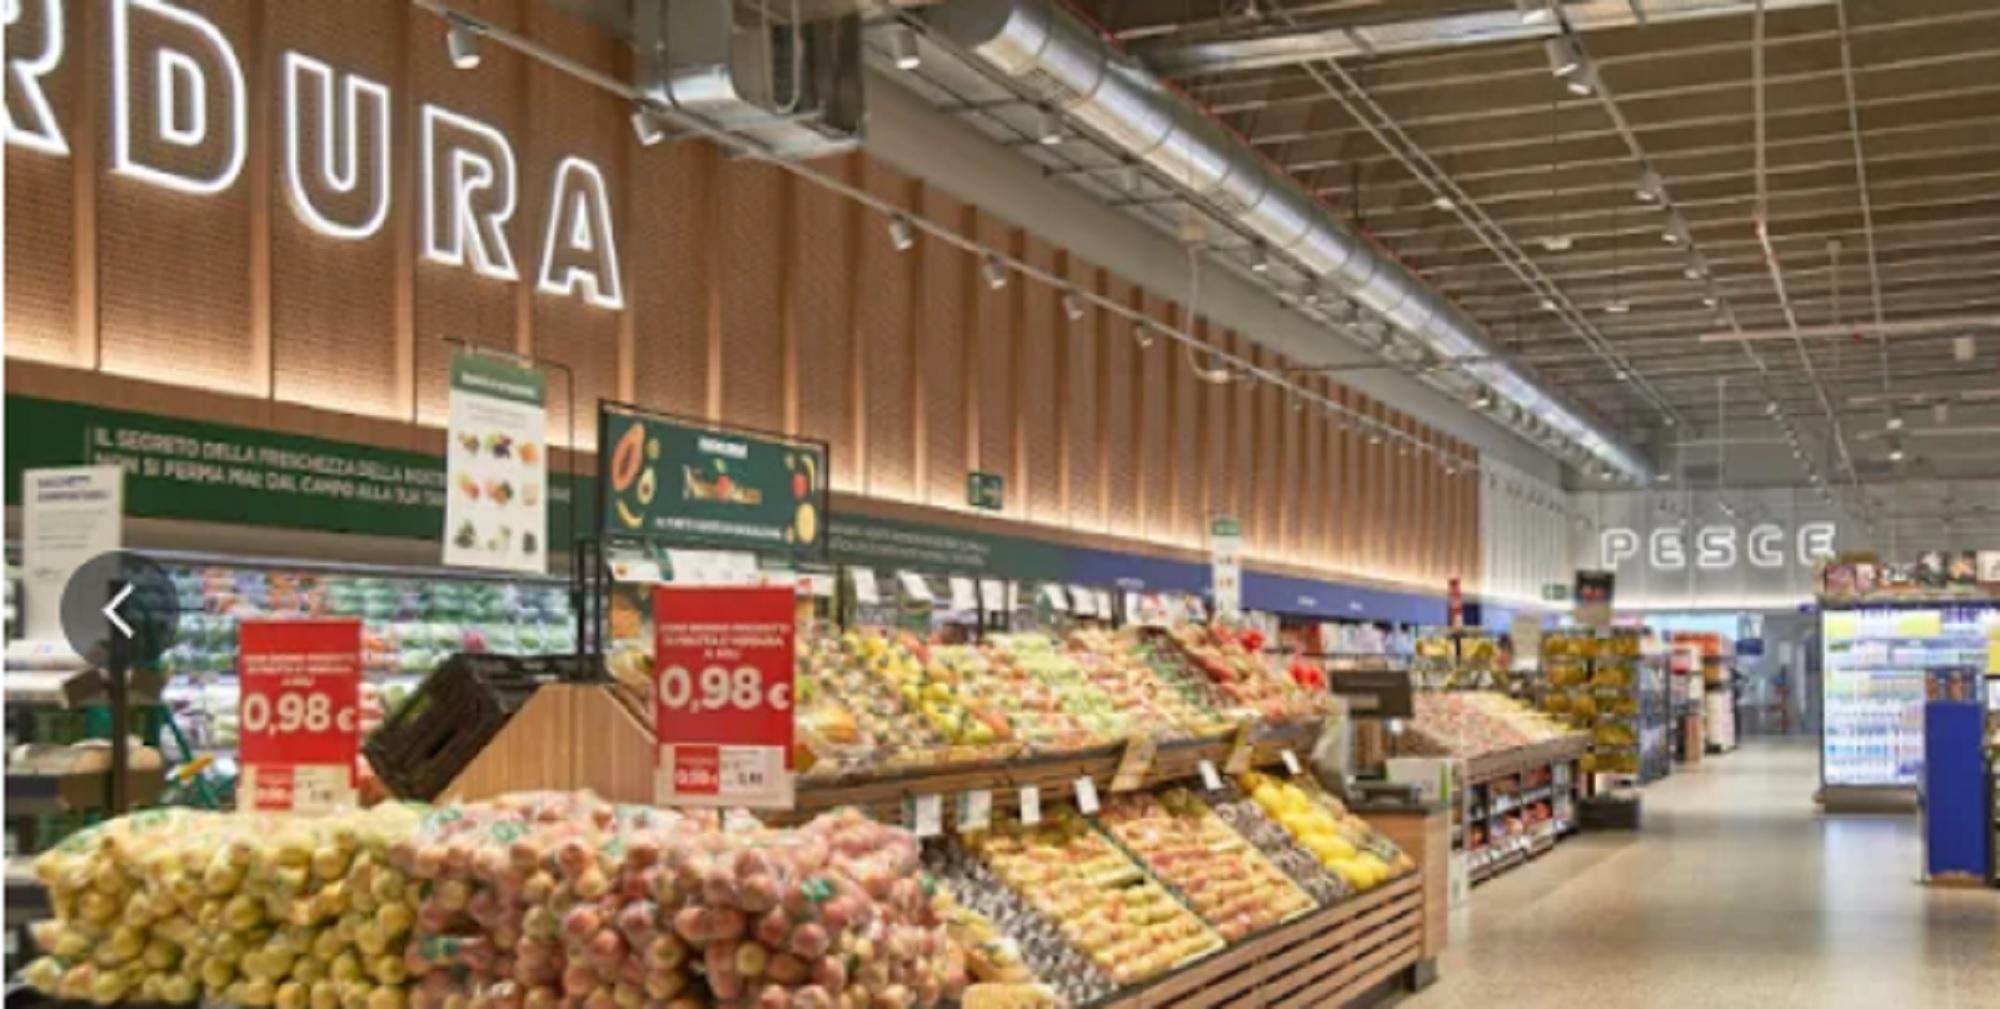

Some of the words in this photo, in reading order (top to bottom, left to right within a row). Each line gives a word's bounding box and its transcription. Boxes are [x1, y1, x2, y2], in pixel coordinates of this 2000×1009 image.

[202, 441, 255, 465] DELLA
[1600, 521, 1837, 570] PESCE
[658, 664, 763, 713] 0,98
[242, 691, 332, 738] 0,98
